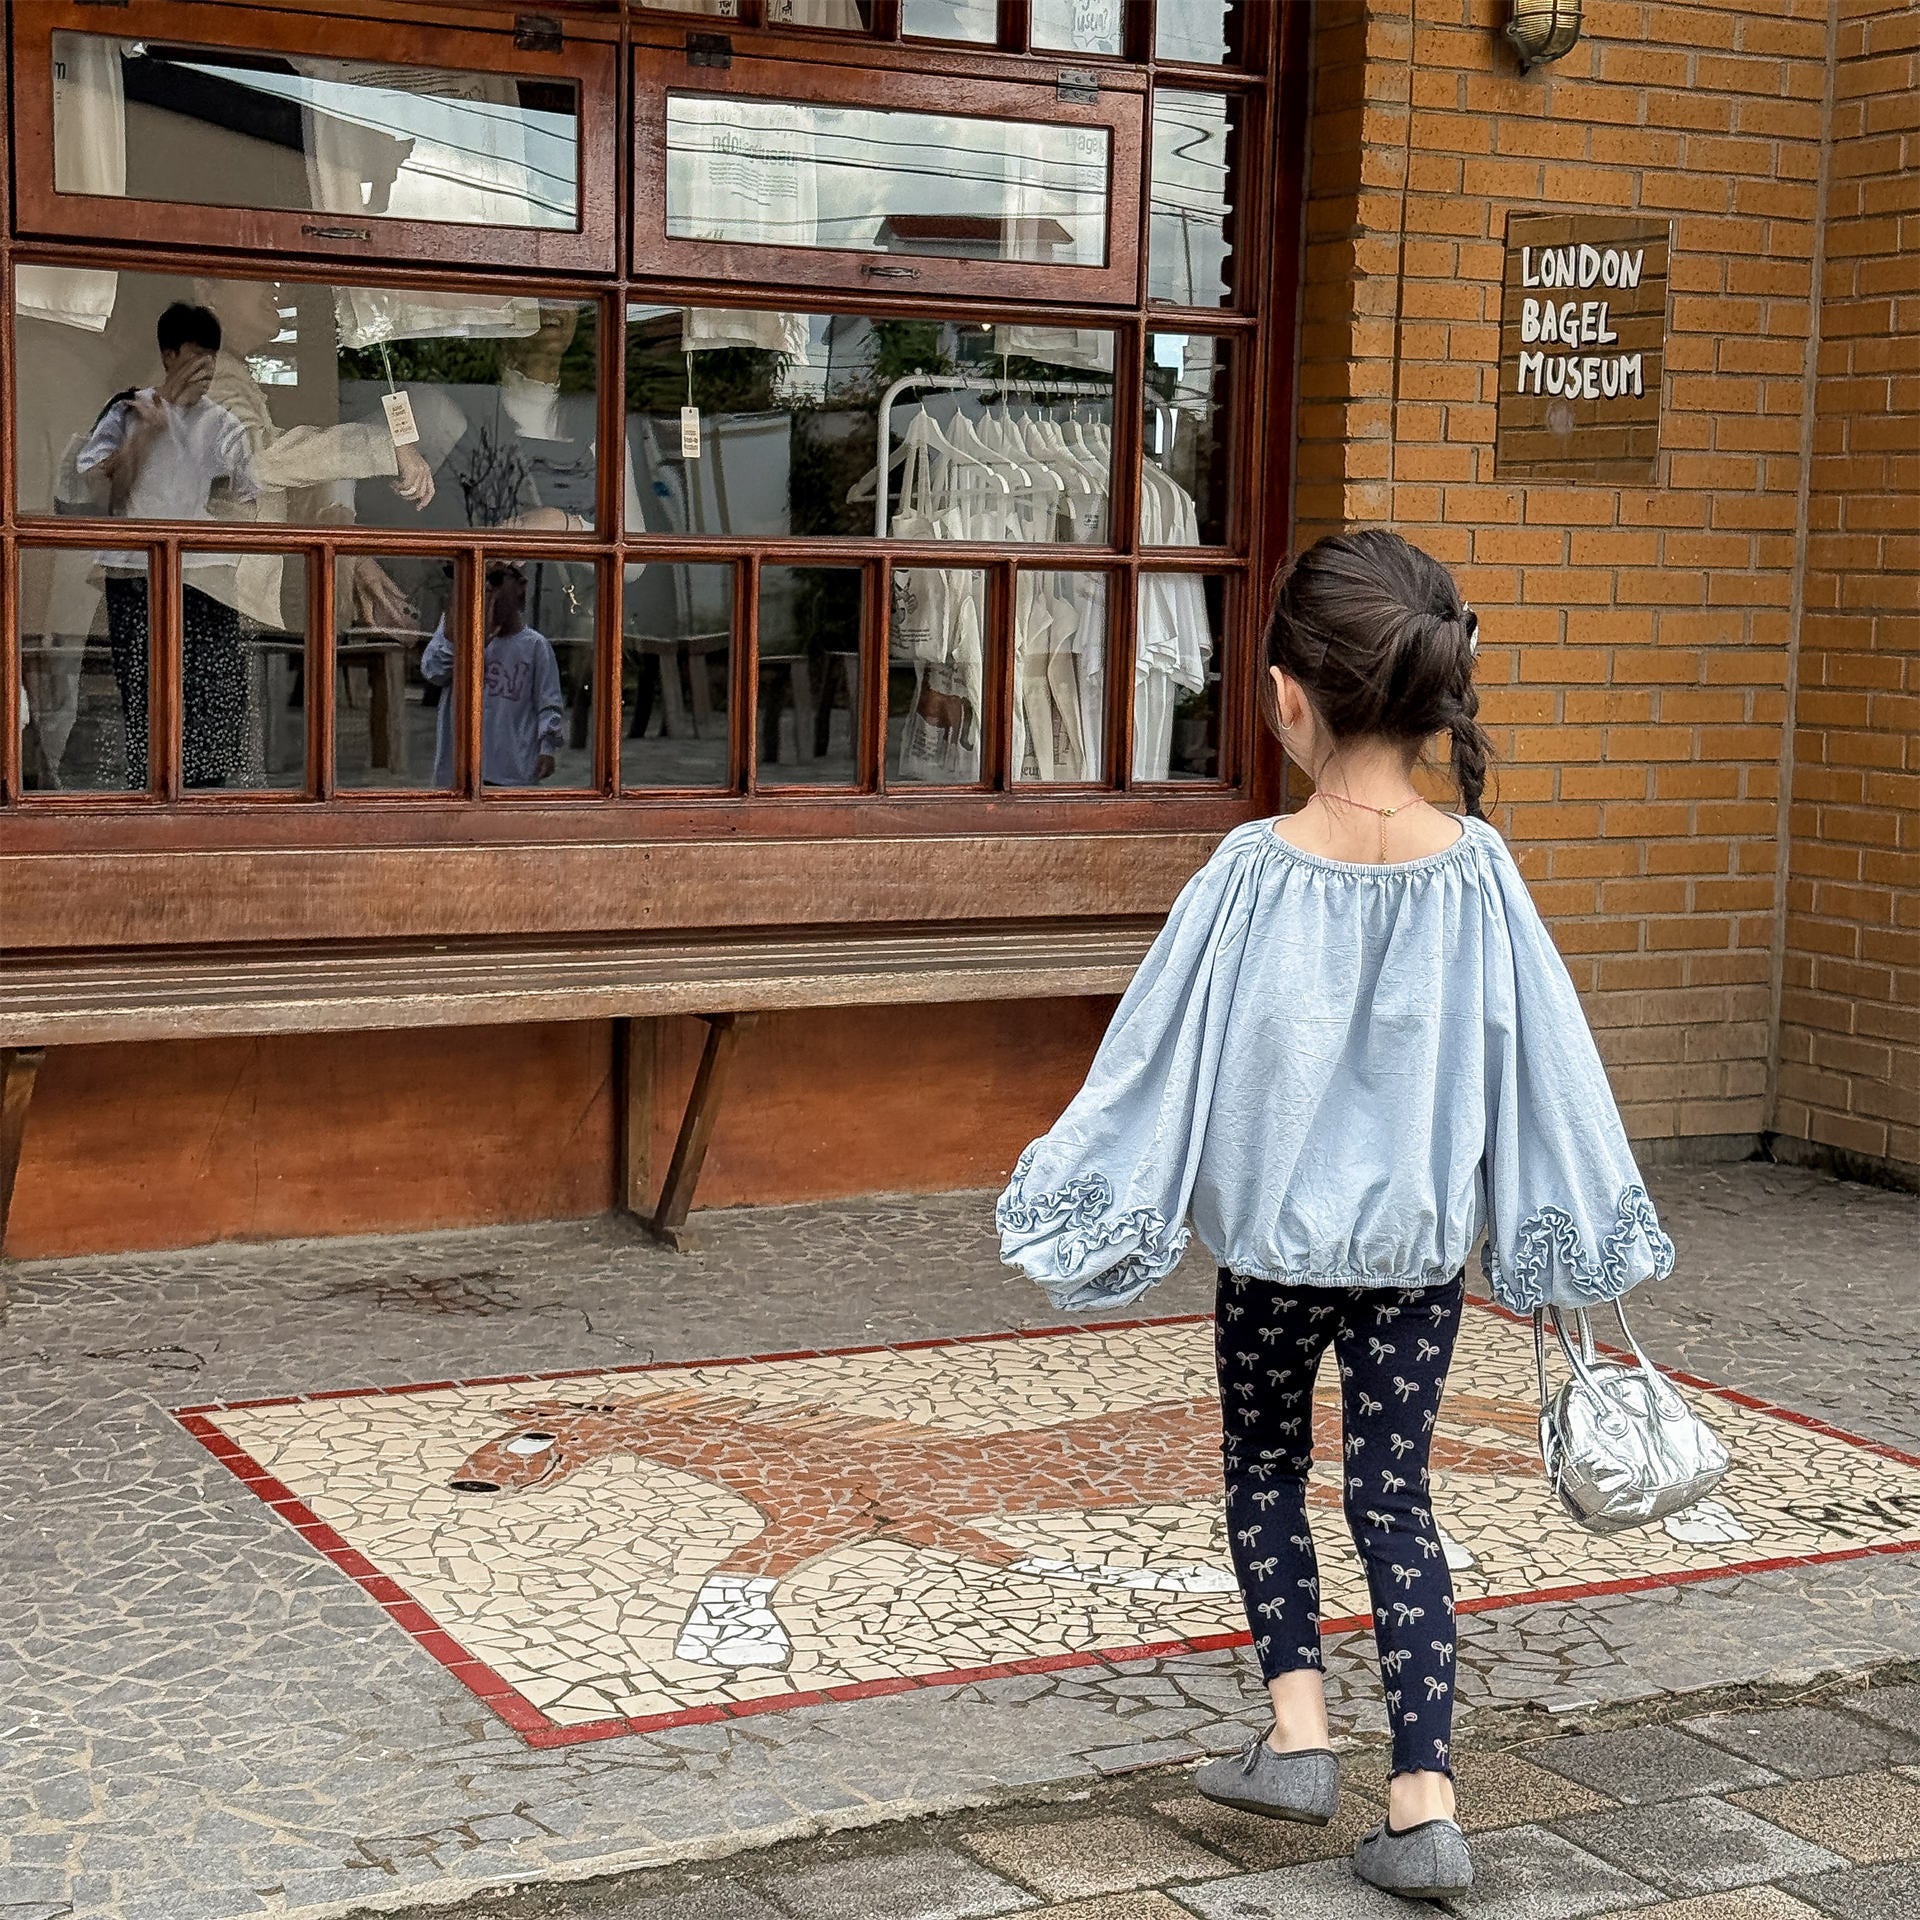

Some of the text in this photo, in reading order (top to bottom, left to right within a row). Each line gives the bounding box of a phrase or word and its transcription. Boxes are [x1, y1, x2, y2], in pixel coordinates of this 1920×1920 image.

[1521, 243, 1644, 289] LONDON
[1521, 298, 1618, 349] BAGEL
[1517, 350, 1643, 400] MUSEUM
